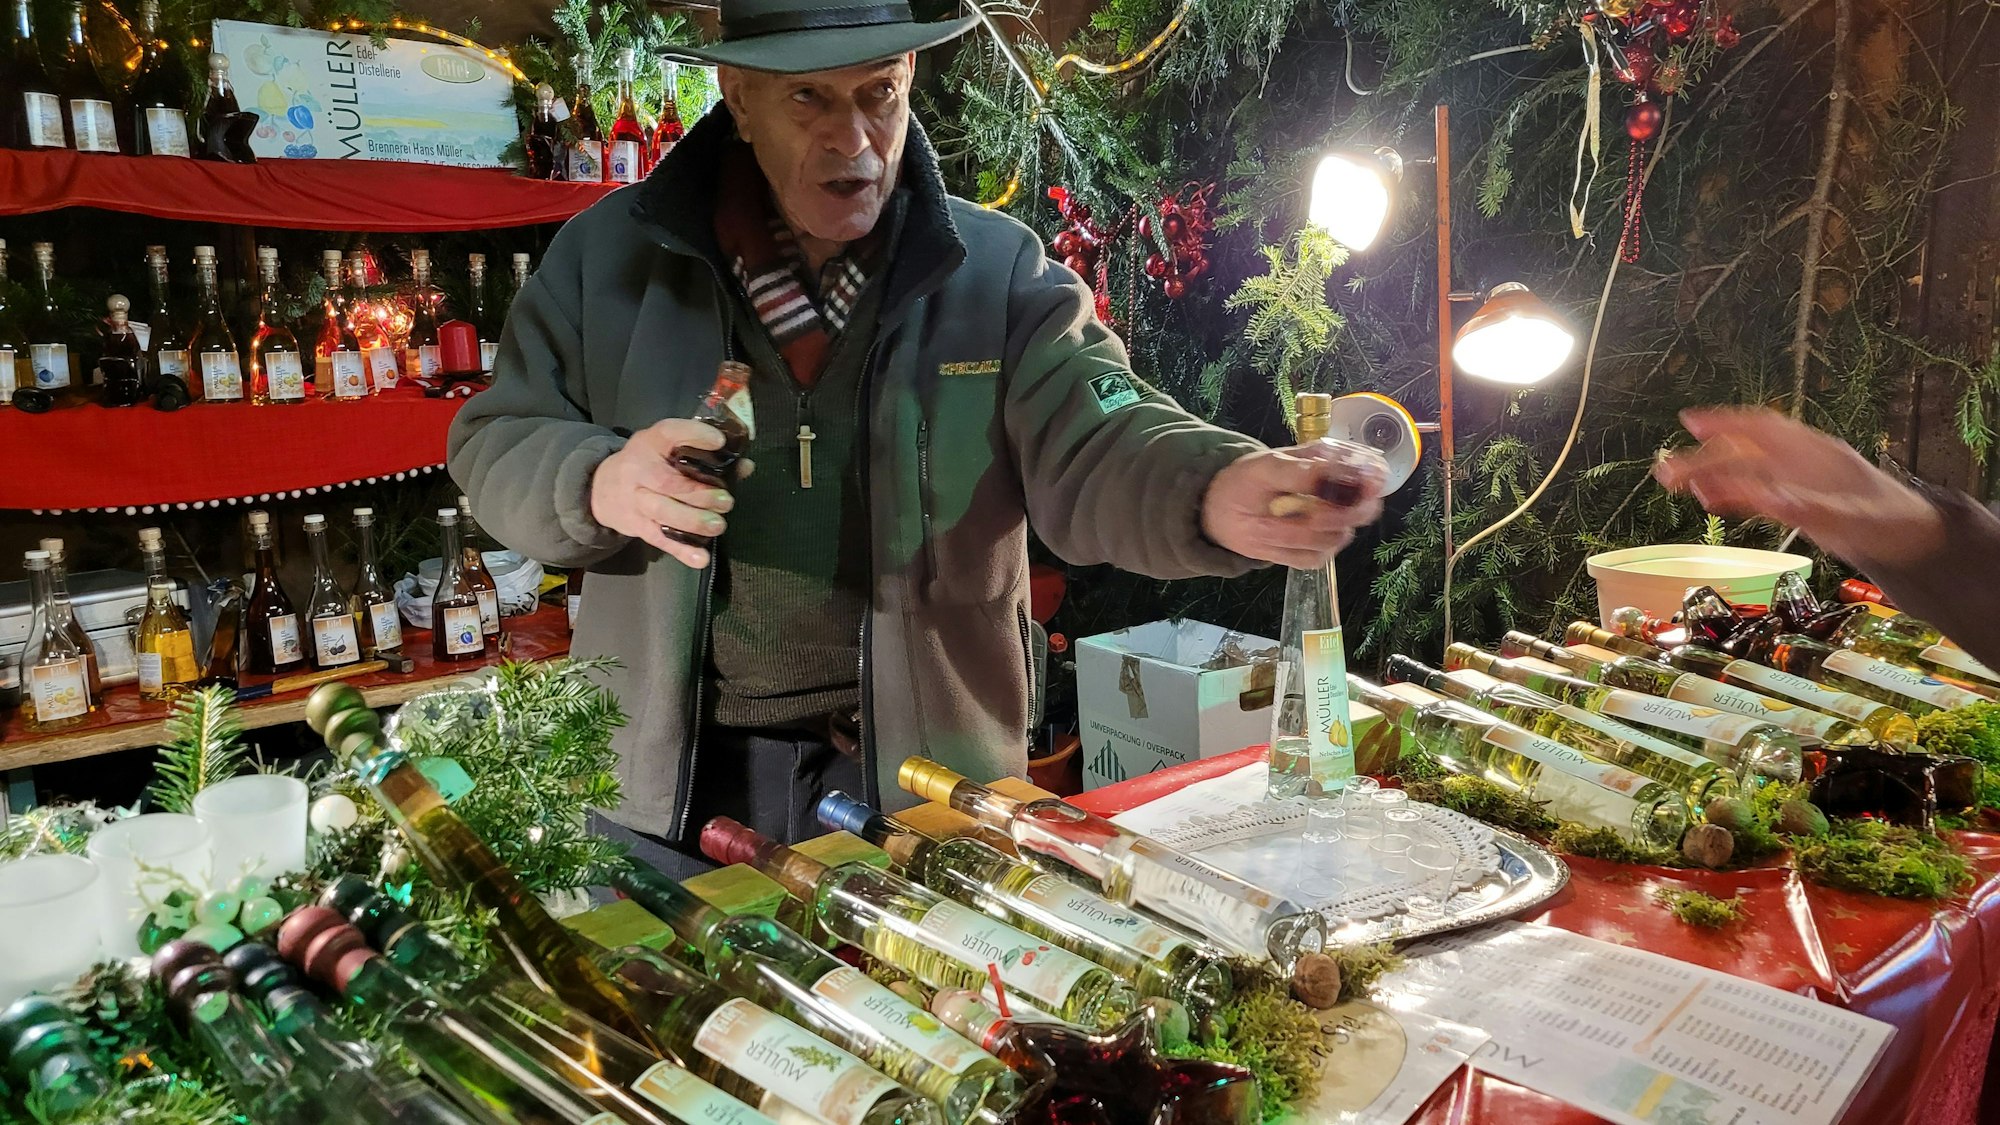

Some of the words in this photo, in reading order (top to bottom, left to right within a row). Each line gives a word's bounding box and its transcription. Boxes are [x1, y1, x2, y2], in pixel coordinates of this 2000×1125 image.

[357, 61, 401, 80] Distellerie
[326, 40, 363, 159] MÜLLER
[368, 139, 411, 155] Brennerei
[413, 141, 435, 156] Hans
[436, 144, 463, 158] Müller
[1319, 633, 1339, 650] Eifel
[1769, 672, 1823, 694] MÜLLER
[1868, 664, 1921, 685] MÜLLER
[1316, 676, 1331, 734] MÜLLER
[1643, 702, 1698, 722] MÜLLER
[1713, 692, 1770, 716] MÜLLER
[1089, 719, 1141, 747] UMVERPACKUNG
[1146, 741, 1186, 762] OVERPACK
[1532, 739, 1589, 765] MÜLLER
[1174, 855, 1223, 879] MÜLLER
[1067, 898, 1117, 926] MÜLLER
[961, 933, 1015, 965] MÜLLER
[863, 995, 913, 1030] MÜLLER
[745, 1039, 808, 1083] MÜLLER
